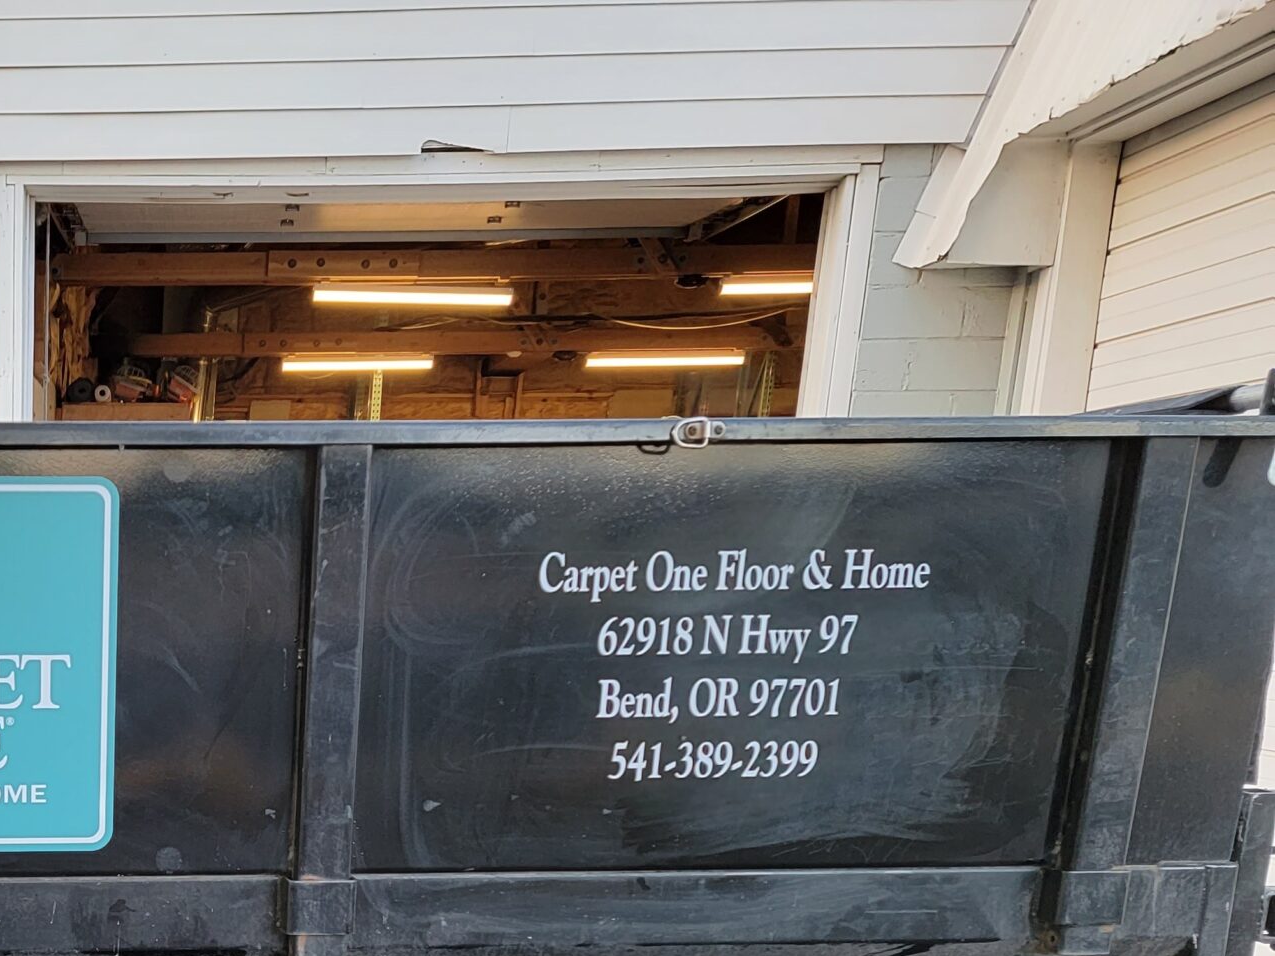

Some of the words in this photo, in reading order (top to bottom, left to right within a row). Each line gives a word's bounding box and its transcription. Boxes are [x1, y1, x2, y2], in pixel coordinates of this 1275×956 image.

[539, 550, 638, 603] Carpet
[646, 550, 707, 592] One
[715, 549, 794, 591] Floor
[802, 549, 832, 590] &
[840, 549, 931, 590] Home
[597, 615, 693, 657] 62918
[700, 615, 734, 655] N
[739, 614, 811, 664] Hwy
[819, 614, 859, 655] 97
[596, 677, 679, 724] Bend,
[688, 677, 741, 718] OR
[749, 677, 840, 718] 97701
[607, 740, 819, 782] 541-389-2399
